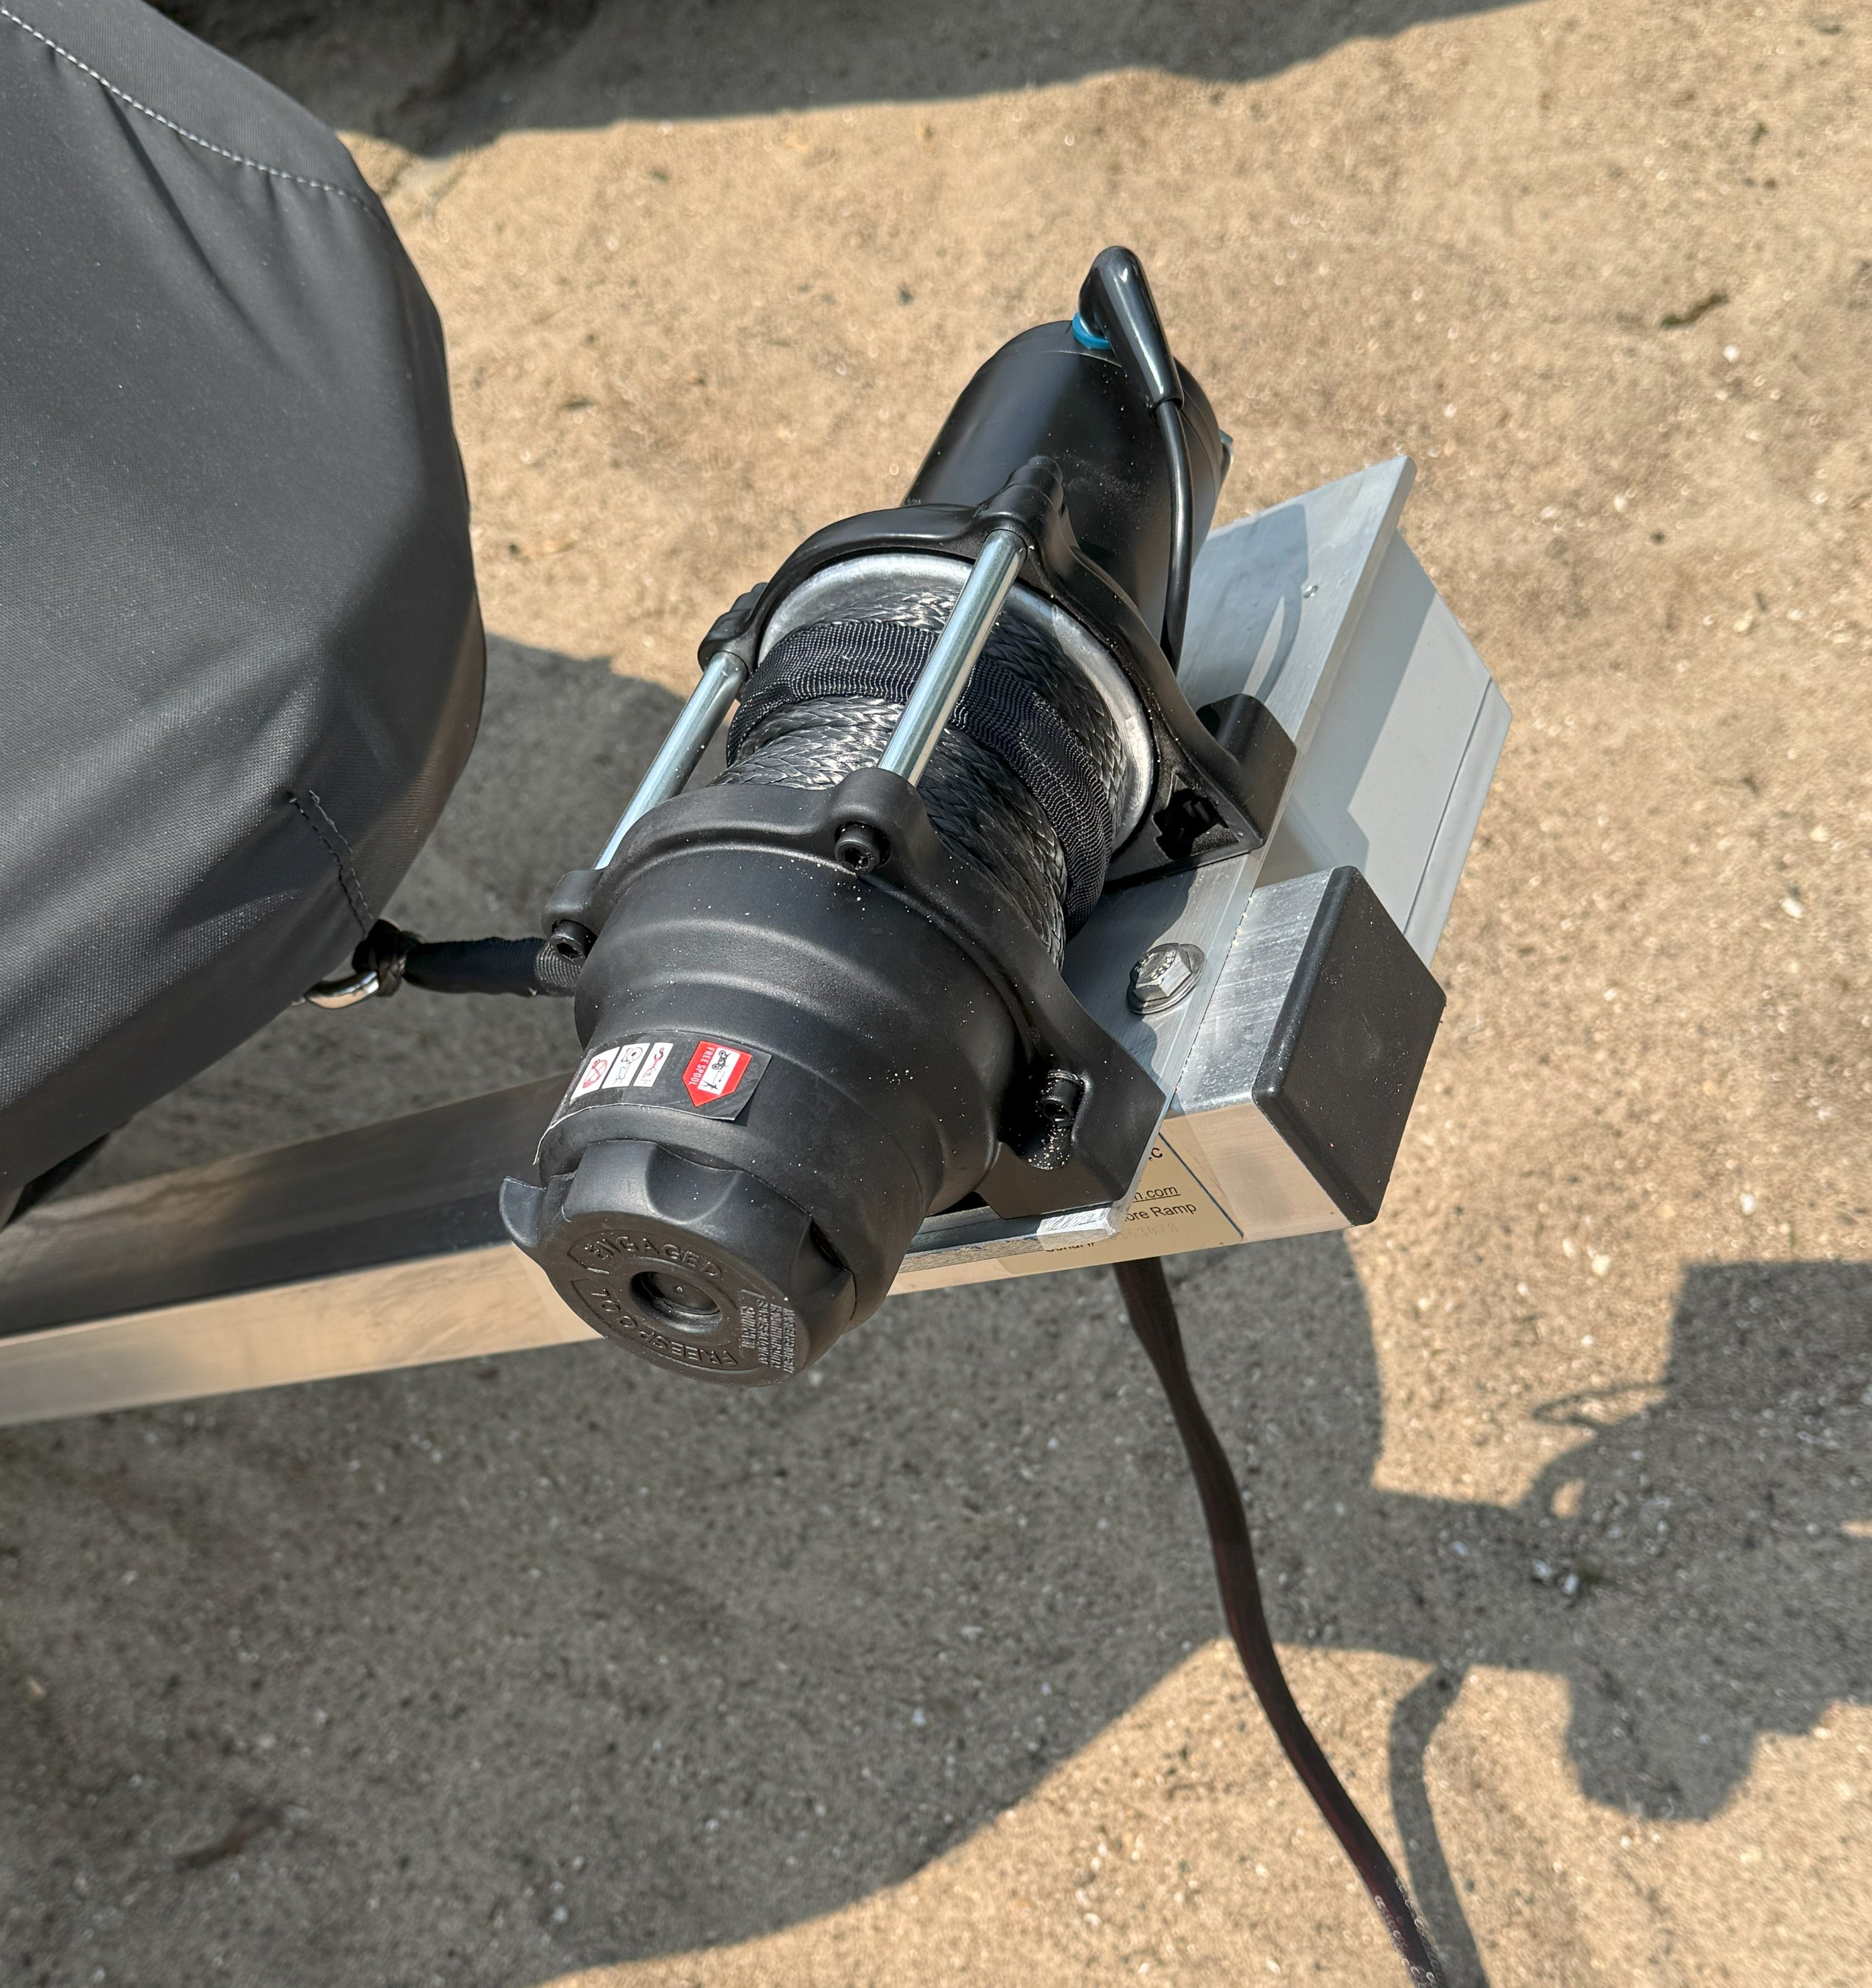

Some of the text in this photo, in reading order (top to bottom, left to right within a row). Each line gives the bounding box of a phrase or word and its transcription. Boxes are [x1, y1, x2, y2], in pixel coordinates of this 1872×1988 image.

[688, 1046, 715, 1085] FREE SPOOL
[1134, 1186, 1178, 1200] n.com
[1125, 1204, 1197, 1221] ore Ramp
